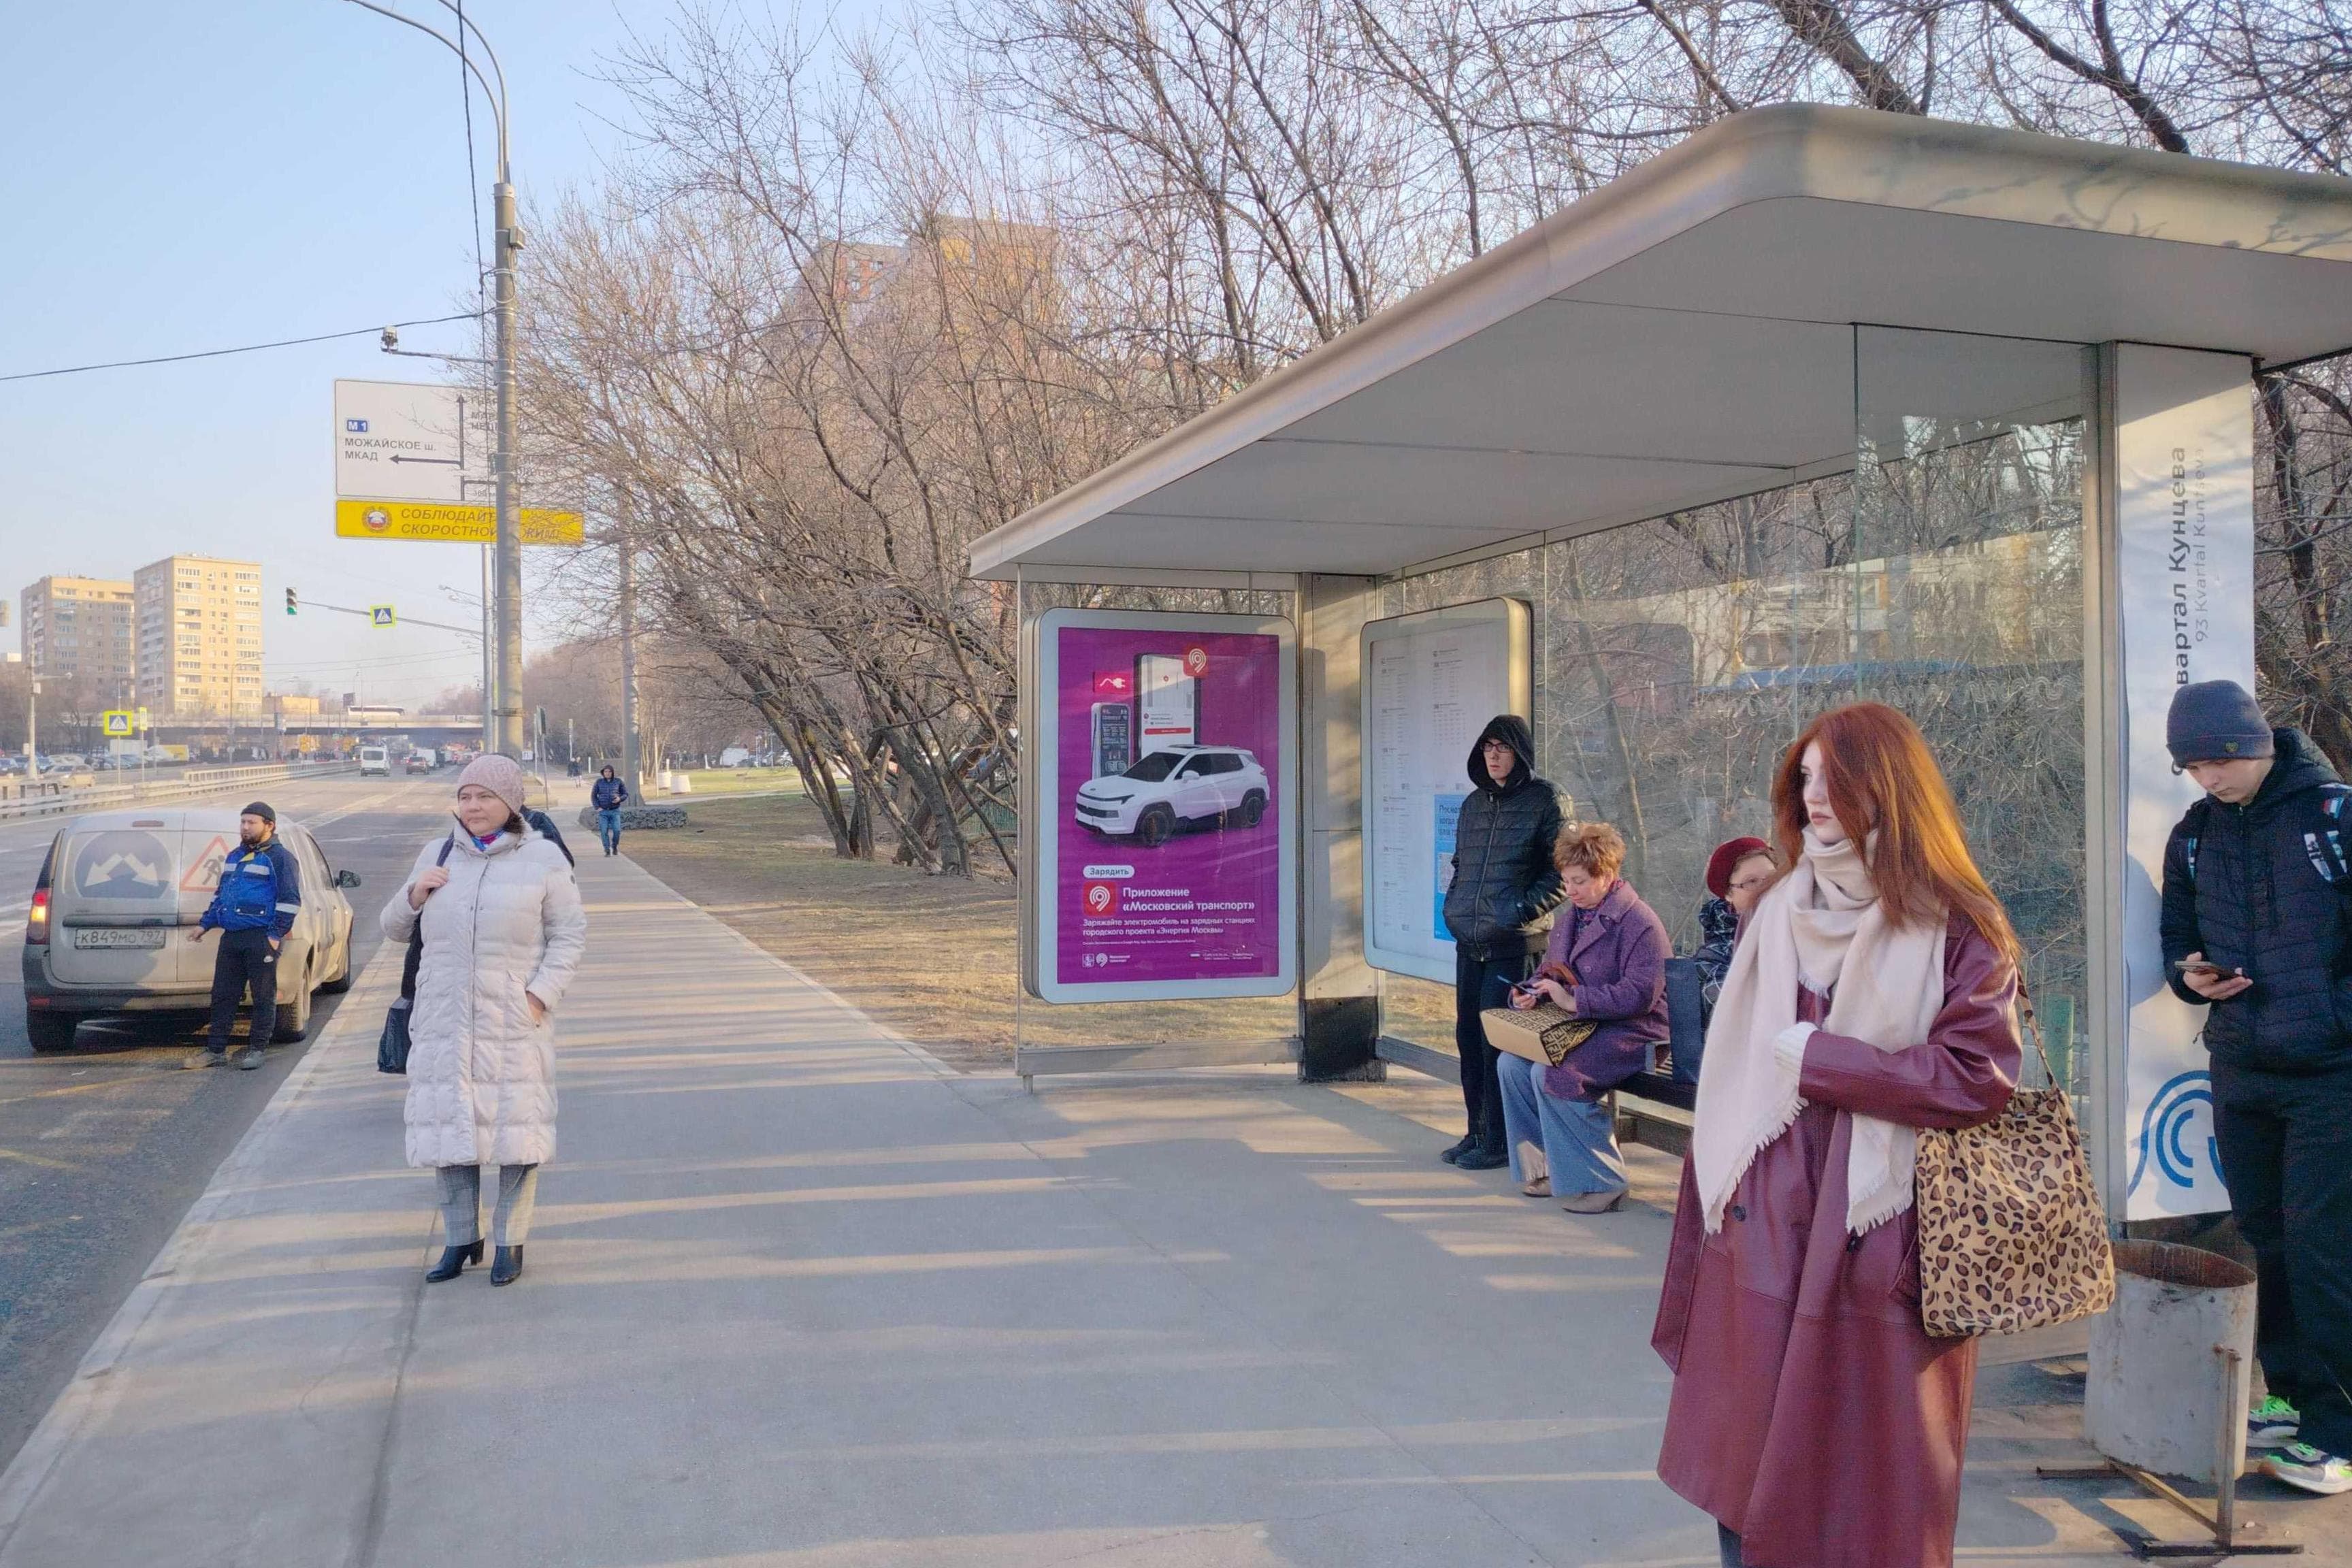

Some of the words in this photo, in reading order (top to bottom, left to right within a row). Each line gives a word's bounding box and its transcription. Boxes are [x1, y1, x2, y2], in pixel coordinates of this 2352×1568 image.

[344, 437, 421, 451] МОЖАЙСКОЕ
[344, 451, 378, 461] МКАД
[402, 508, 496, 523] СОБЛЮДАЙТ
[2169, 447, 2190, 572] Кунцева
[2193, 544, 2208, 611] Kvartal
[2174, 583, 2191, 685] вартал
[2195, 618, 2208, 641] 93
[1090, 867, 1129, 877] Зарядить
[1123, 887, 1190, 899] Приложение
[1123, 900, 1194, 912] «Московский
[1196, 902, 1255, 913] транспорт»
[1083, 919, 1122, 927] Заряжайте
[1124, 917, 1179, 926] электромобиль
[1083, 928, 1124, 936] городского
